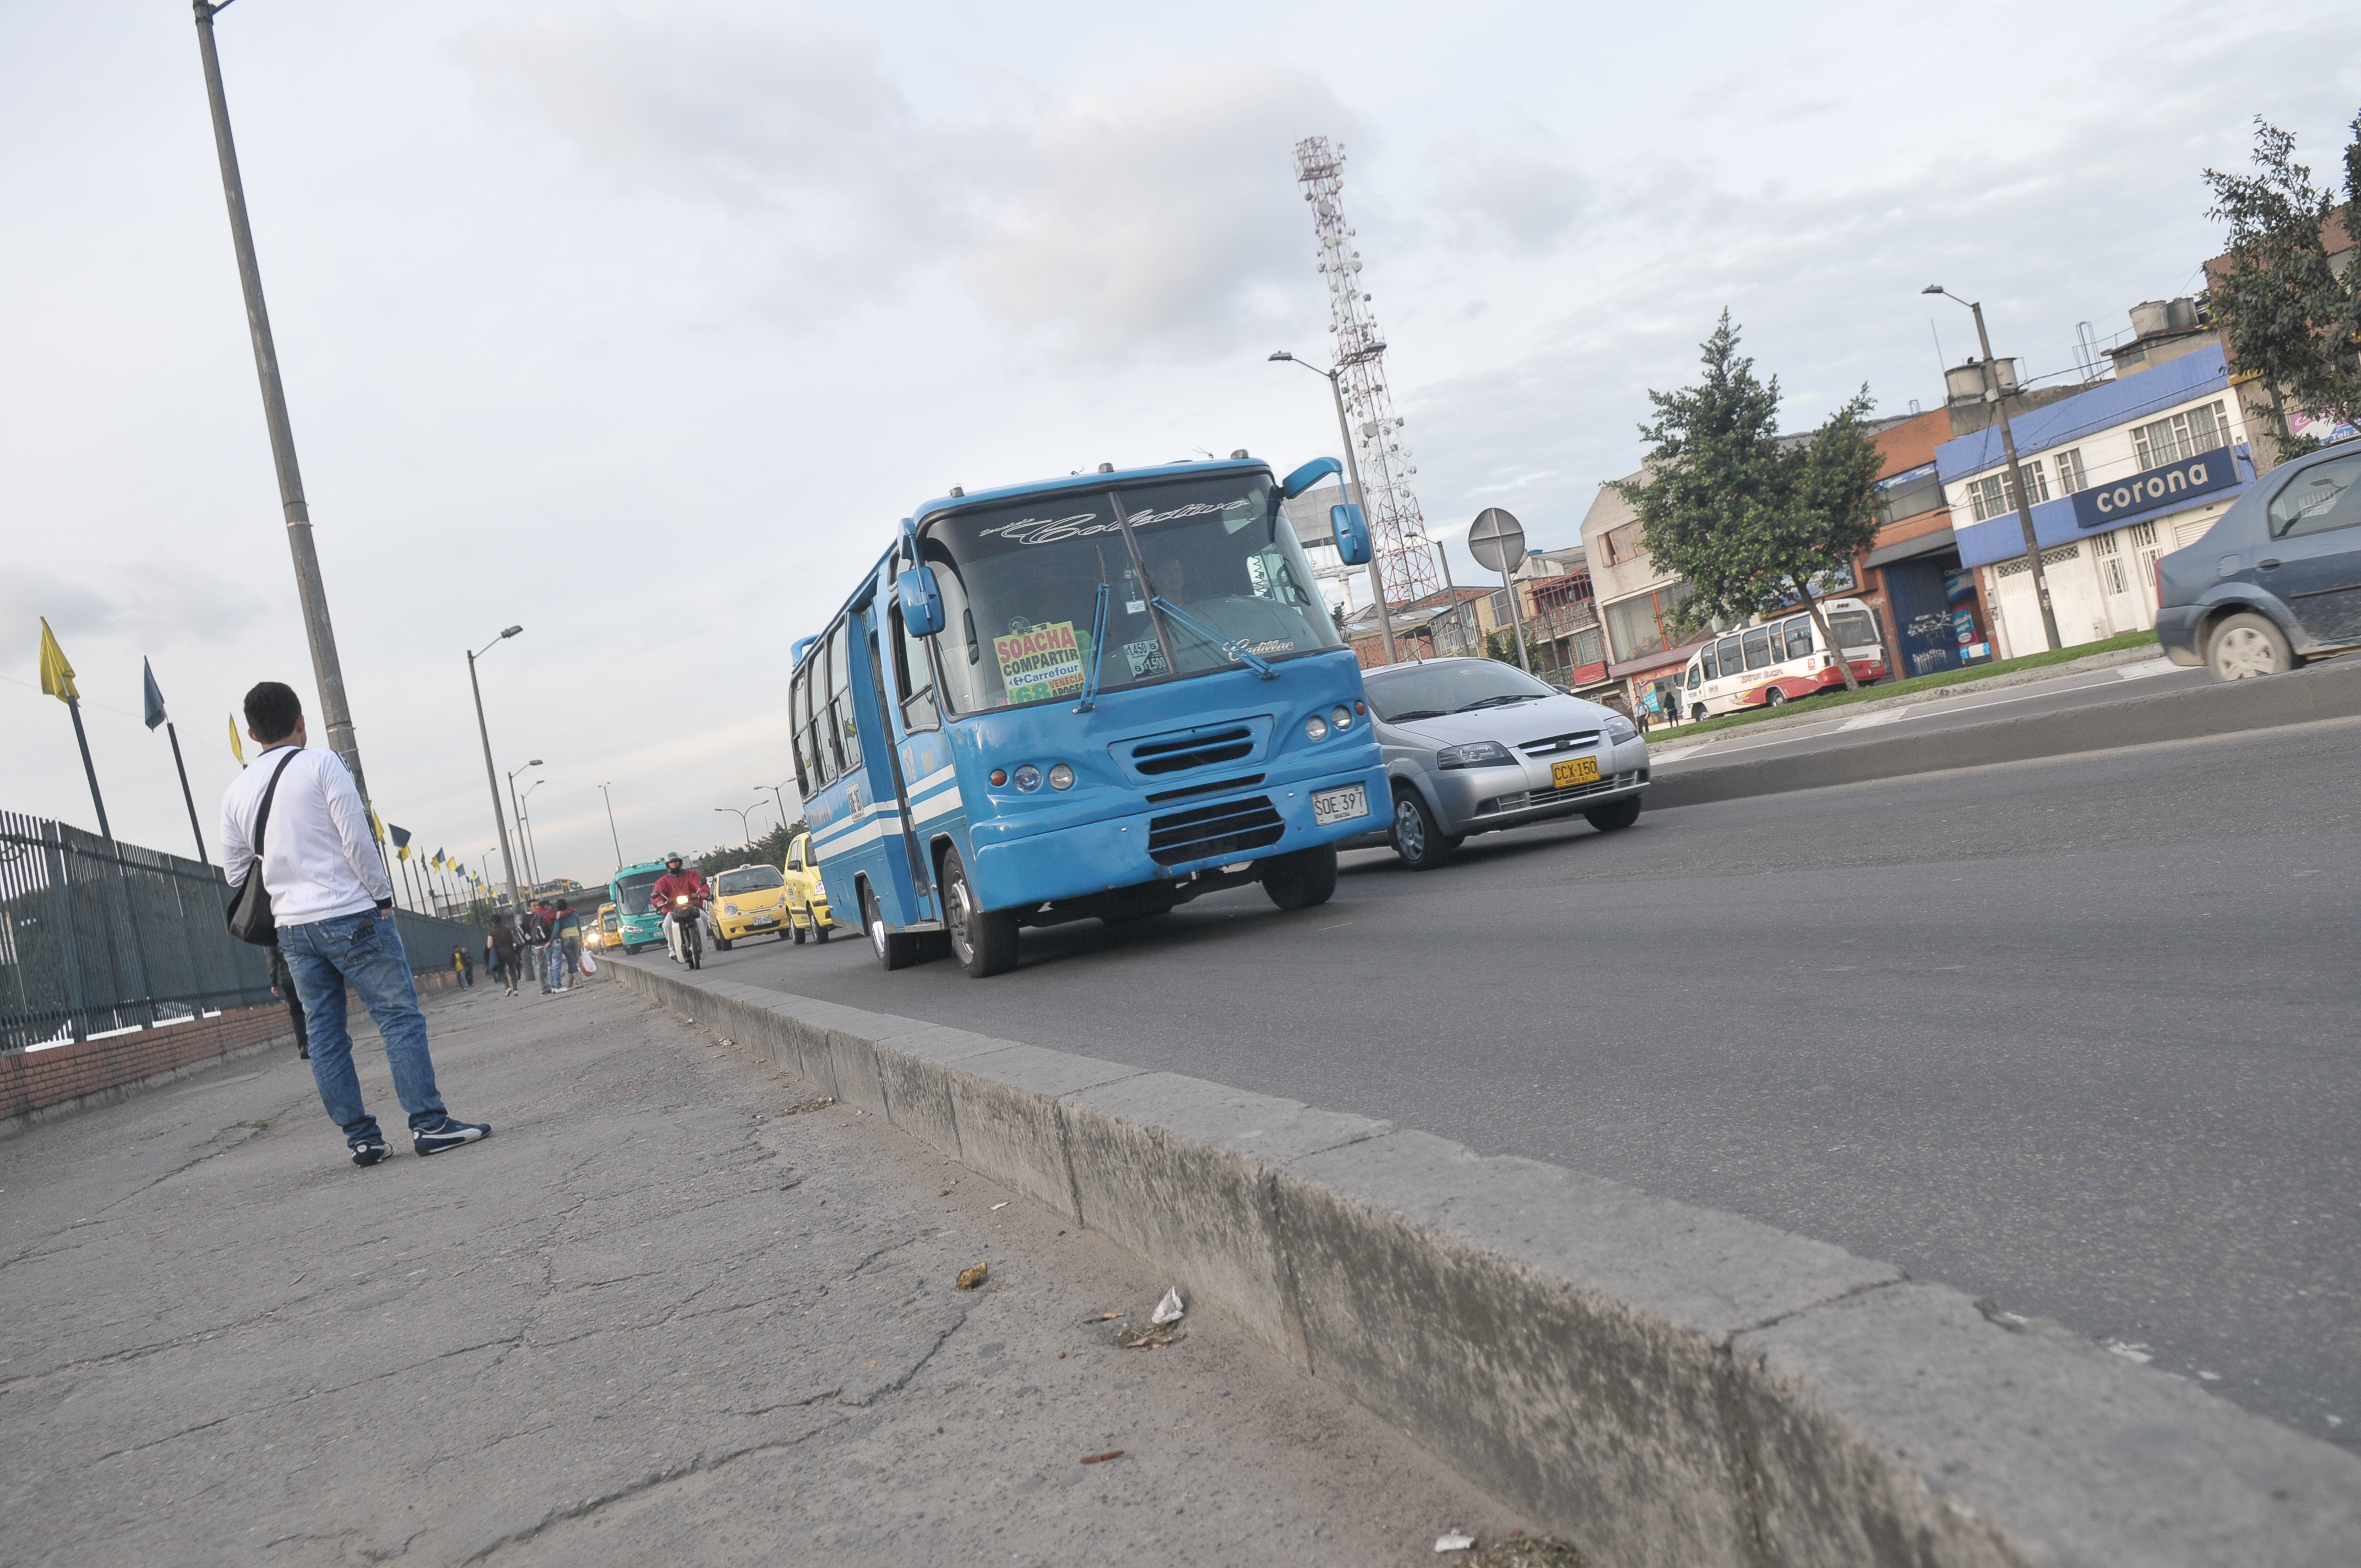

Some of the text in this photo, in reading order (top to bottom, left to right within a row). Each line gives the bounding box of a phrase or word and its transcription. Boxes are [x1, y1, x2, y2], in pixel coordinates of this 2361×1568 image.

[2331, 430, 2350, 440] Tel:
[2097, 463, 2208, 513] corona
[997, 627, 1076, 664] SOACHA
[1221, 638, 1294, 661] Cadillac
[1003, 648, 1079, 677] COMPARTIR
[1024, 665, 1079, 683] Carrefour
[1048, 674, 1085, 689] VENECIA
[1016, 683, 1051, 704] 68
